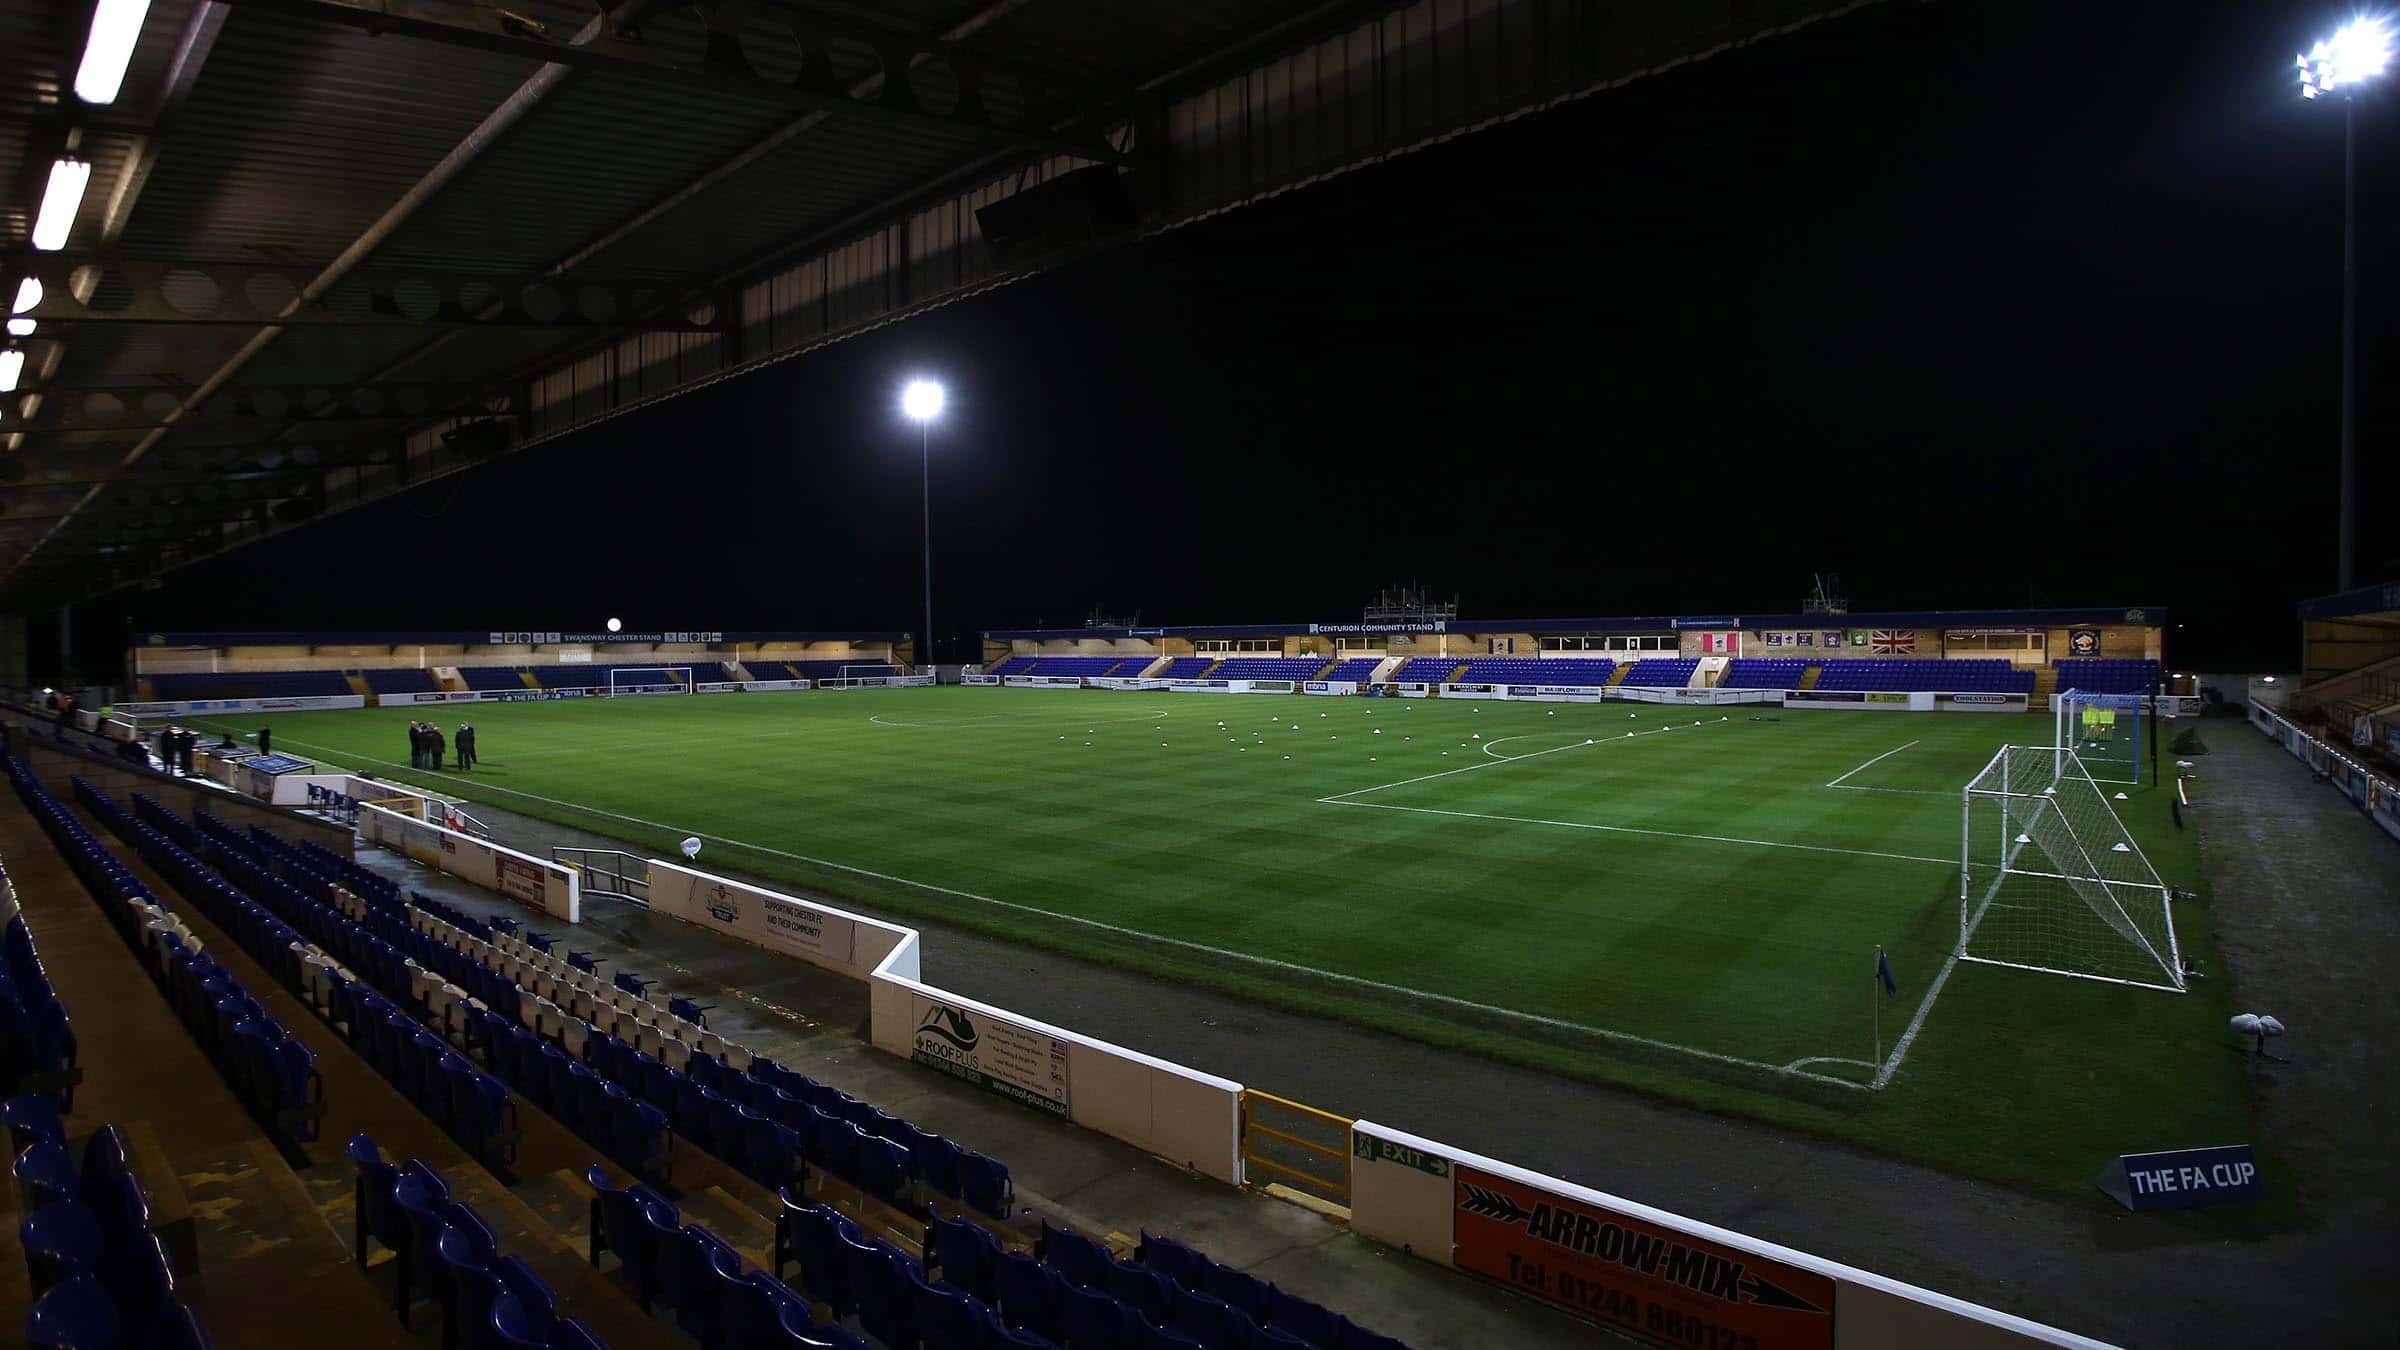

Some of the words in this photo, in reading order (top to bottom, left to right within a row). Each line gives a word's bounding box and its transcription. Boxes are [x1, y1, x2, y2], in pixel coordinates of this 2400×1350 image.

[564, 634, 606, 642] SWANSWAY
[1318, 624, 1360, 633] CENTURION
[1360, 623, 1407, 633] COMMUNITY
[1407, 623, 1434, 632] STAND
[763, 900, 794, 917] SUPPORTING
[794, 907, 815, 922] CHESTER
[815, 913, 823, 924] FC
[767, 915, 777, 926] AND
[791, 920, 822, 939] COMMUNITY
[1382, 1143, 1424, 1169] EXIT
[2129, 1168, 2178, 1195] THE
[2179, 1166, 2211, 1191] FA
[2212, 1161, 2255, 1188] CUP
